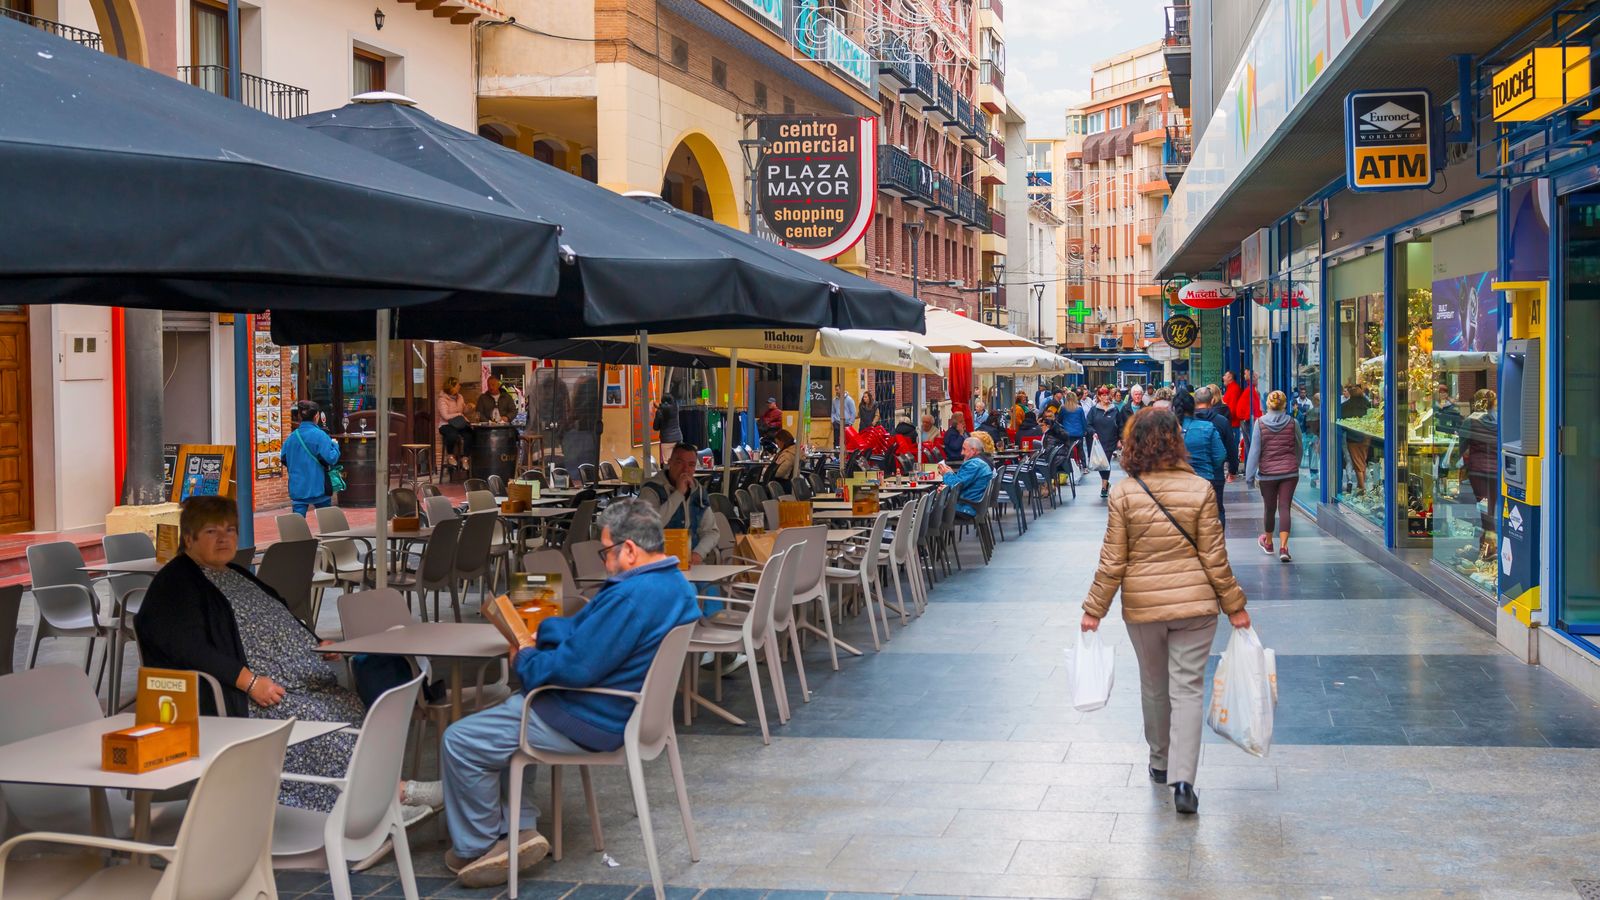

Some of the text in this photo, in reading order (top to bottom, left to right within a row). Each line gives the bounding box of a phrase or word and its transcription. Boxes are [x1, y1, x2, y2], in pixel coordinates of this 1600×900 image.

[1493, 59, 1534, 108] TOUCHÉ
[1370, 112, 1410, 122] Euronet
[780, 121, 837, 137] centro
[768, 164, 849, 179] PLAZA
[1359, 154, 1426, 179] ATM
[768, 181, 849, 196] MAYOR
[774, 206, 844, 223] shopping
[786, 225, 833, 238] center
[1186, 288, 1218, 299] Musetti
[764, 330, 804, 342] Mahou
